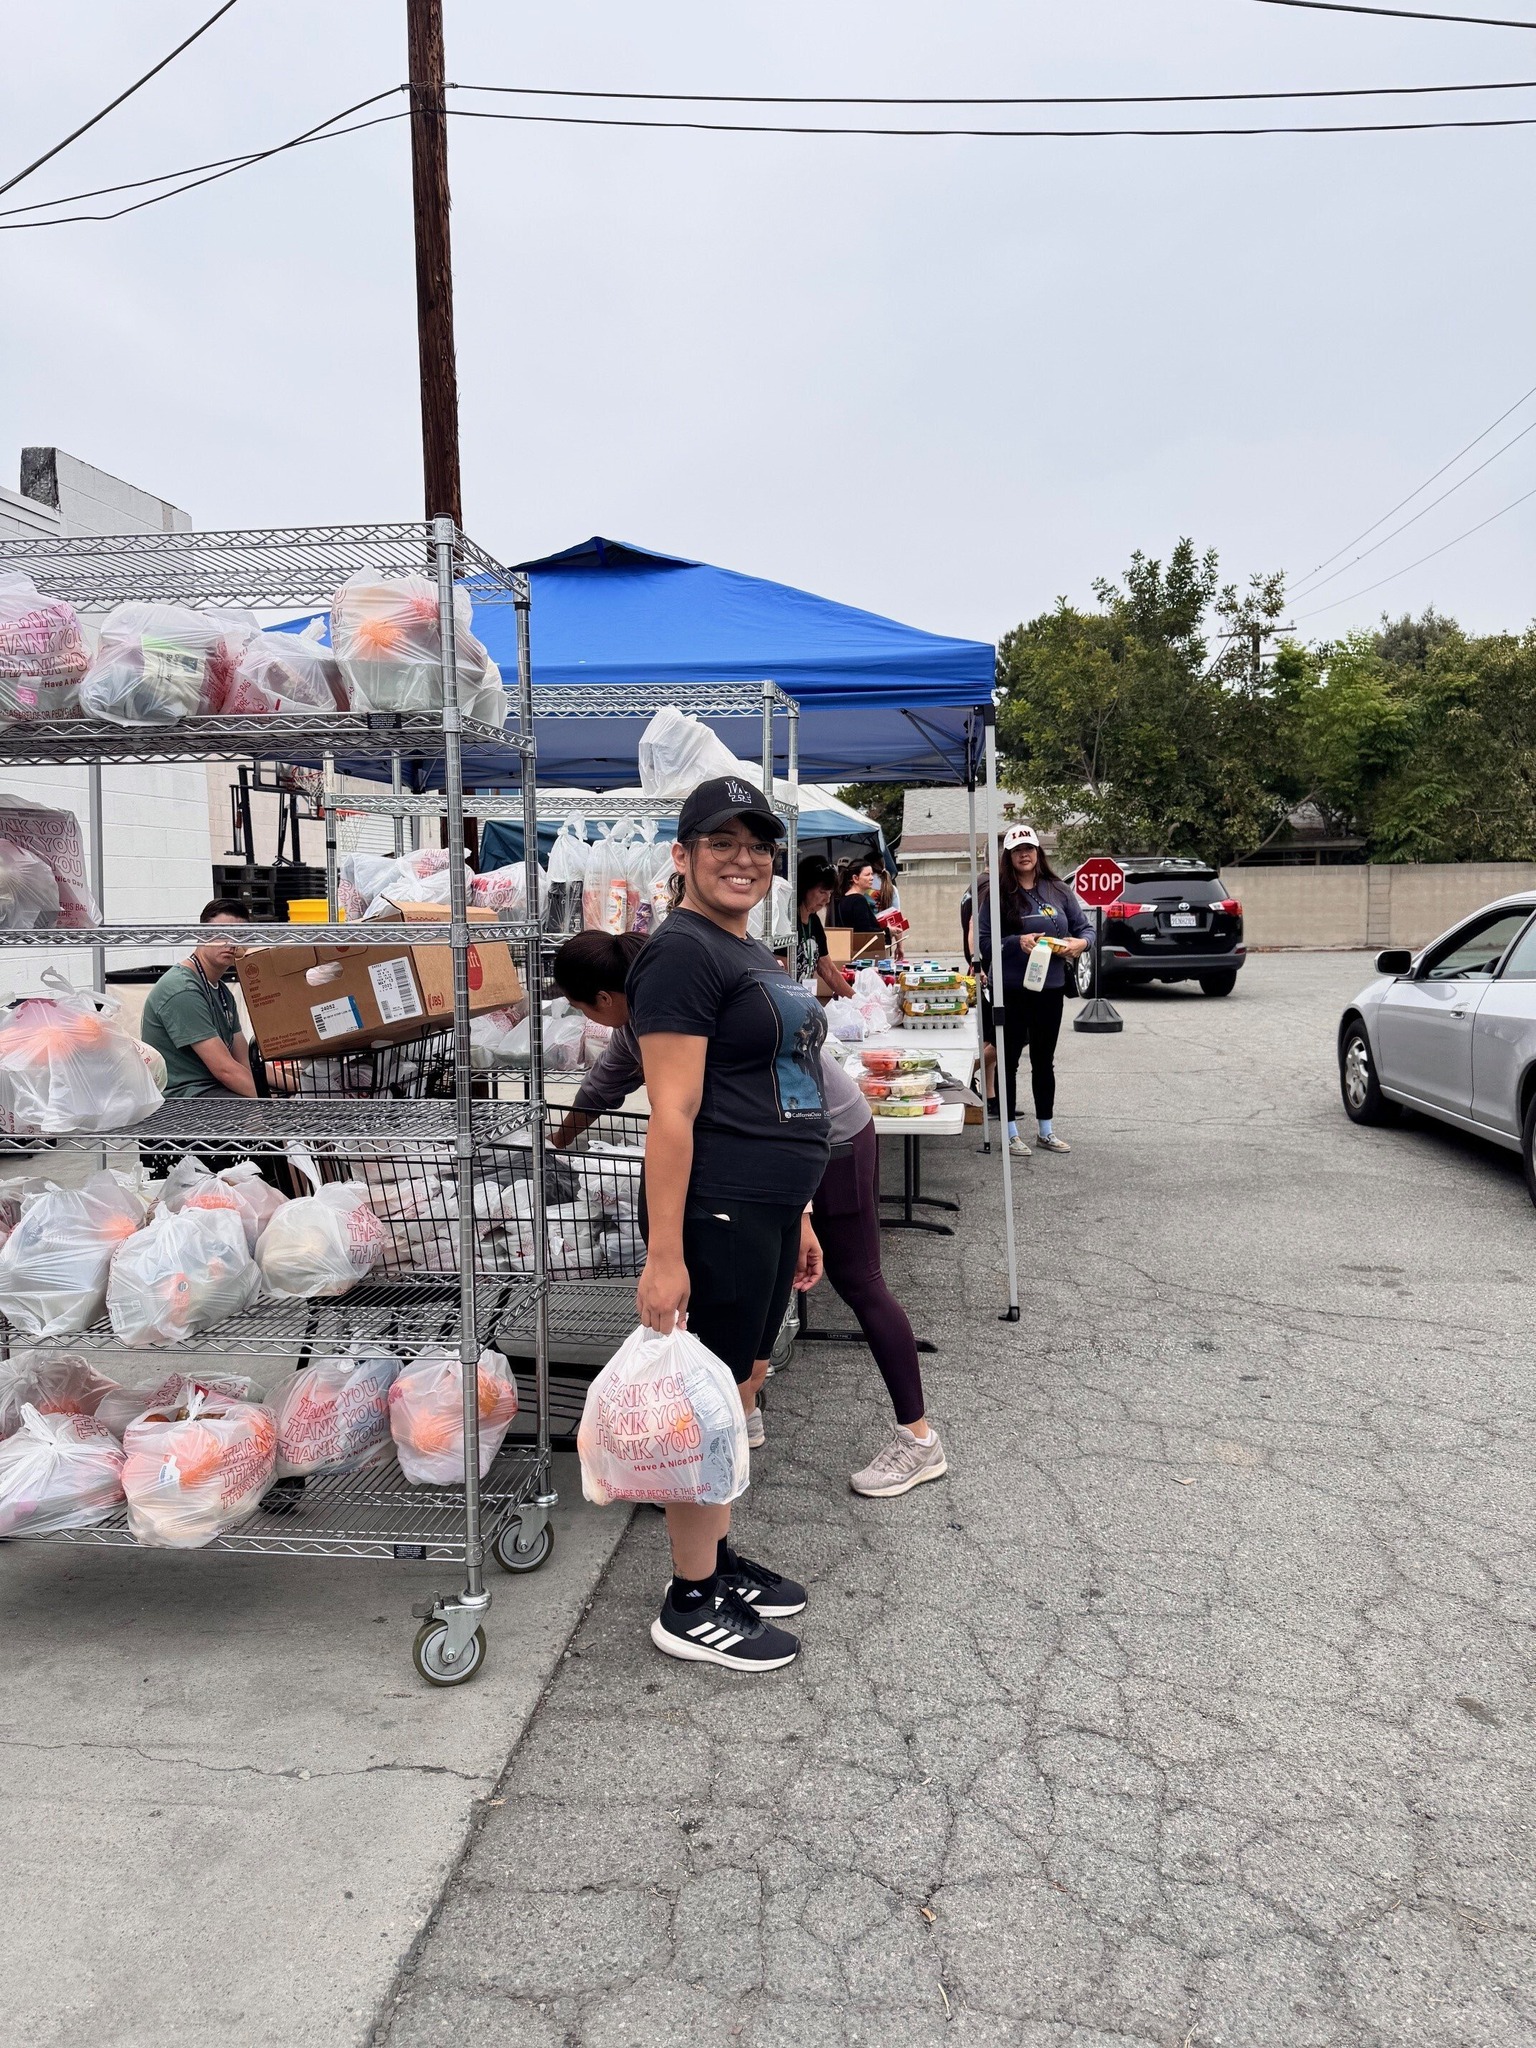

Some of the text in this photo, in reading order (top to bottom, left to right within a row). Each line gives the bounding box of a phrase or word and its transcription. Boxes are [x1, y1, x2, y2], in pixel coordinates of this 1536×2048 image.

[0, 632, 57, 656] HANK
[57, 652, 88, 672] YO
[33, 819, 76, 837] YOU
[1018, 830, 1032, 838] AM
[38, 837, 80, 857] YOU
[46, 855, 83, 877] YOU
[1078, 873, 1124, 892] STOP
[340, 1376, 379, 1407] YOU
[603, 1372, 648, 1408] THANK
[652, 1371, 685, 1402] YOU
[285, 1397, 384, 1443] THANK YOU
[598, 1396, 649, 1436] THANK
[652, 1397, 694, 1430] YOU
[223, 1429, 272, 1466] THAN
[277, 1418, 385, 1465] THANK YOU
[596, 1423, 702, 1461] THANK YOU
[633, 1452, 704, 1472] Have A Nice Day
[635, 1488, 646, 1497] OR
[680, 1484, 696, 1496] THIS
[696, 1481, 712, 1495] BAG
